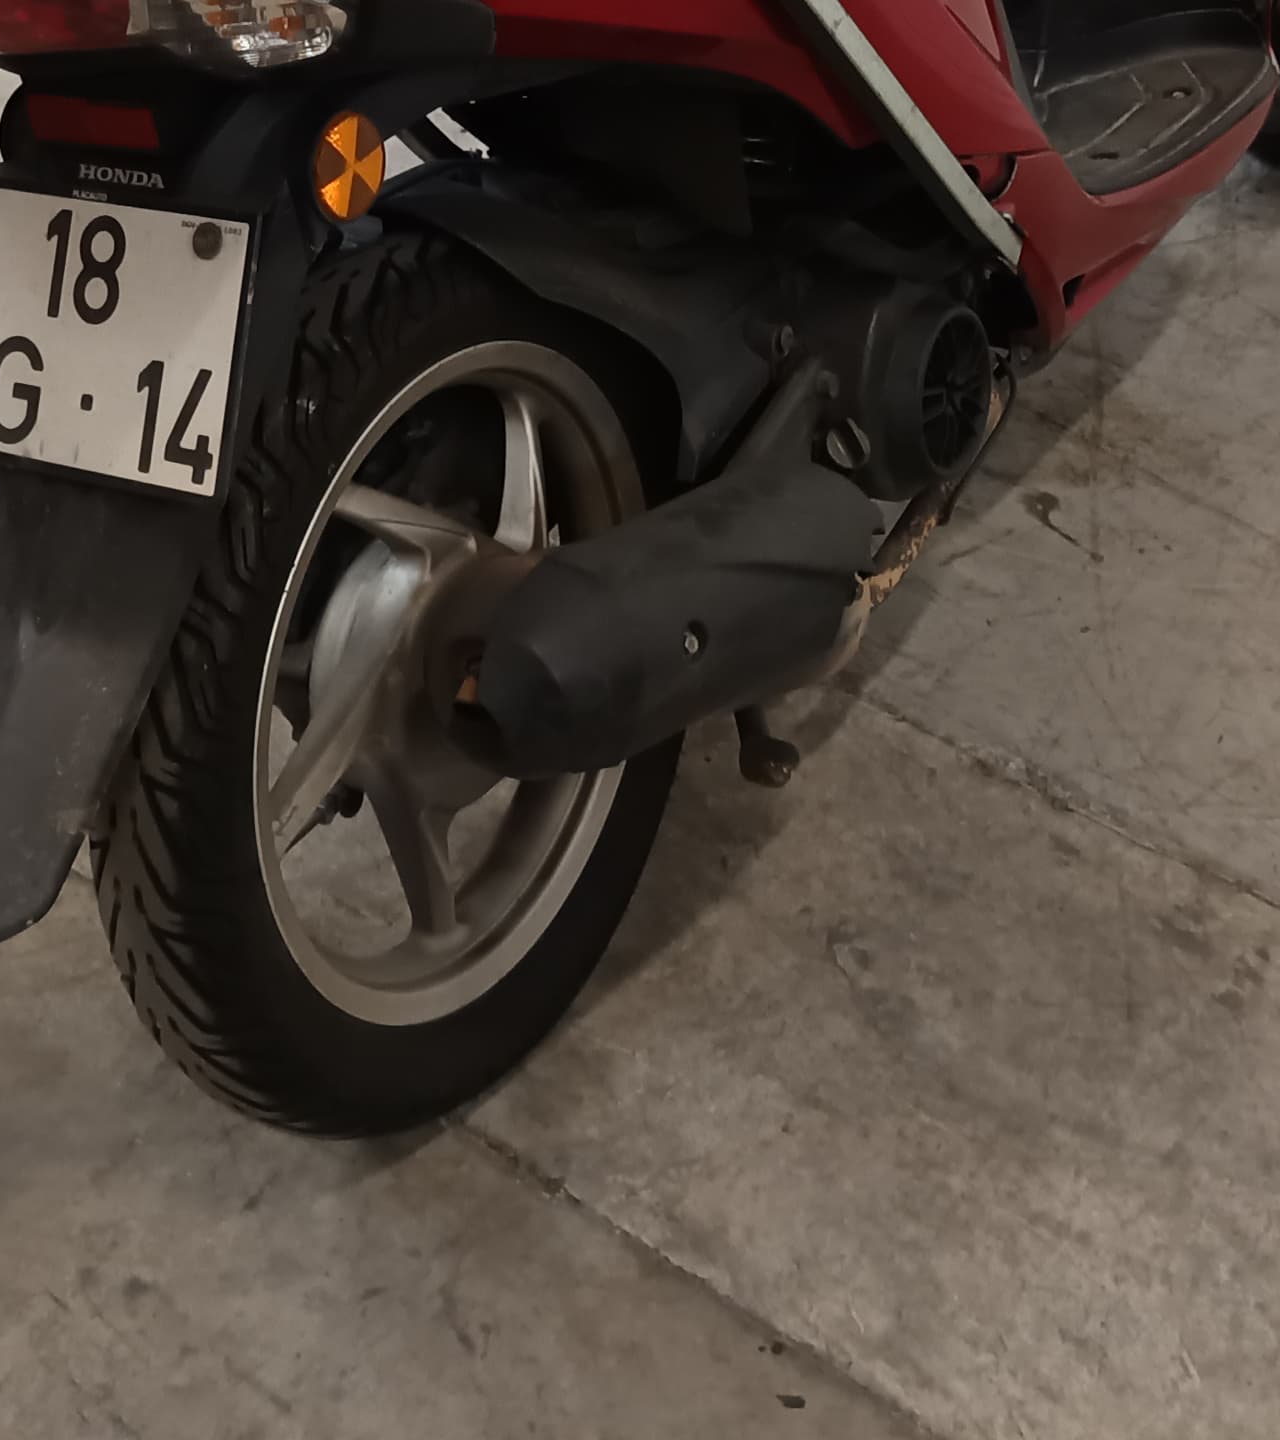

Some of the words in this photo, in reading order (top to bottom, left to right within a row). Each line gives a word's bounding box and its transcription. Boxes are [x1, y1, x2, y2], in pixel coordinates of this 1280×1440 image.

[79, 163, 165, 189] HONDA
[46, 208, 127, 325] 18
[136, 359, 214, 485] 14
